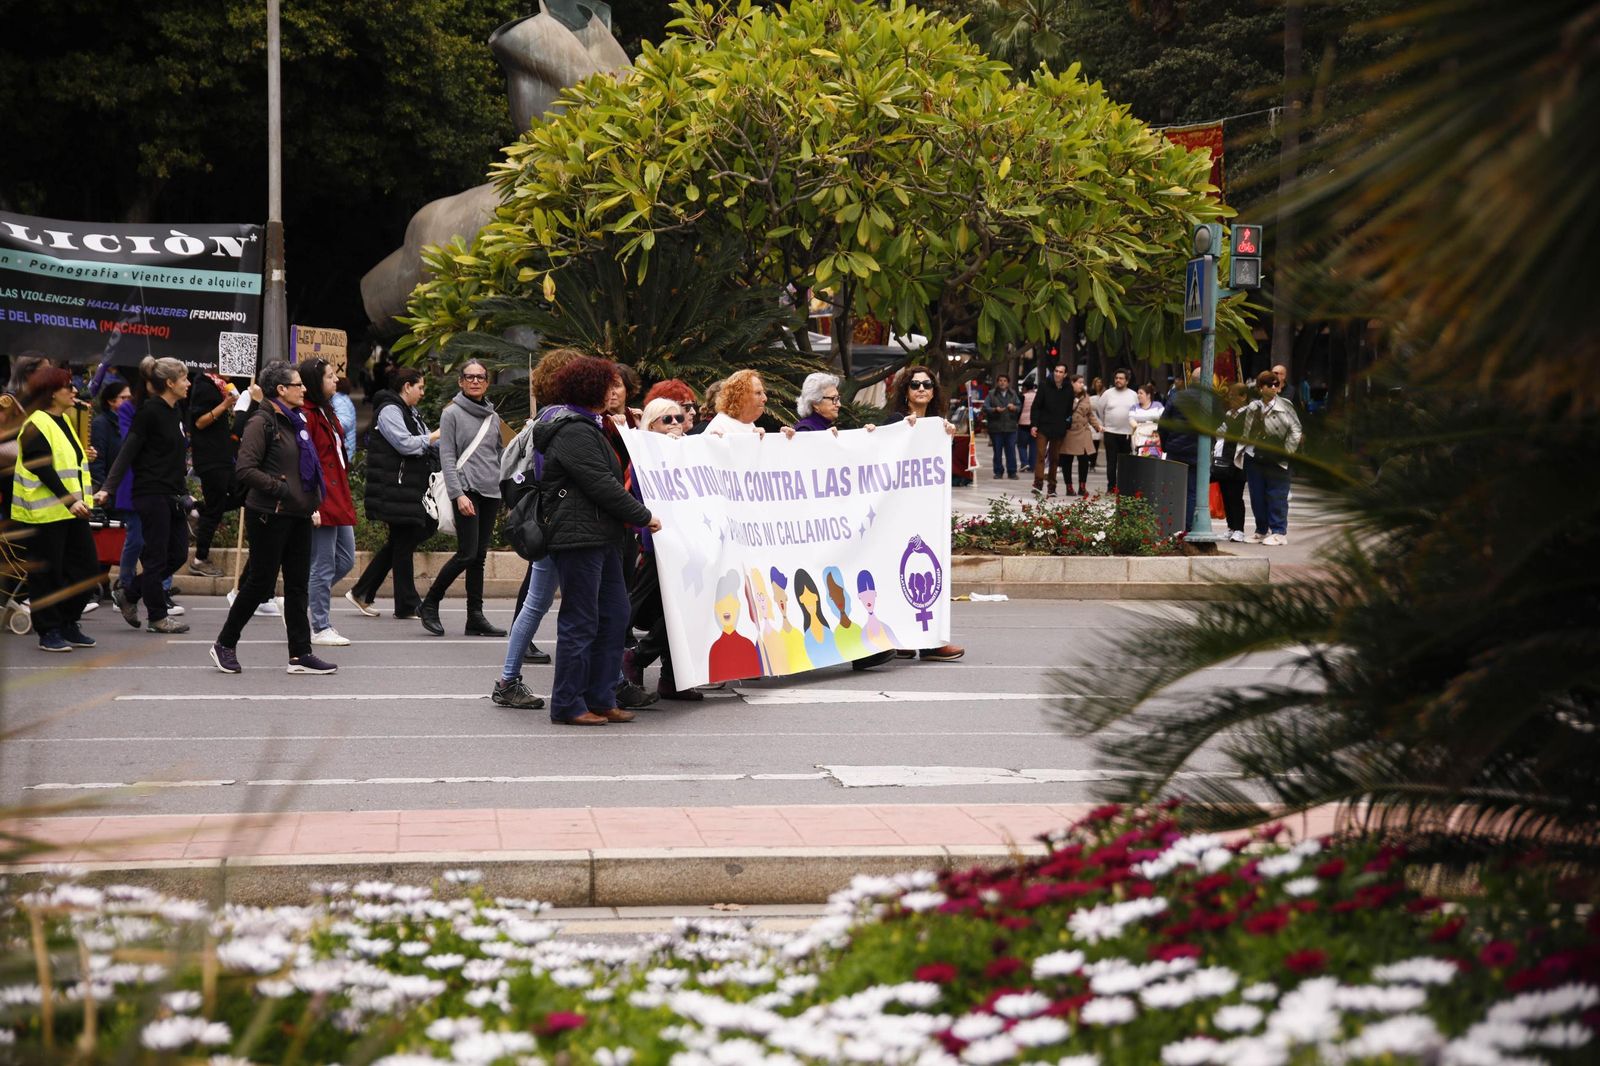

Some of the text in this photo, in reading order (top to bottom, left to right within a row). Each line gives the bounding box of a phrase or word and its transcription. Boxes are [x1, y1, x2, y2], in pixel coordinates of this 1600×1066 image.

[131, 271, 185, 284] Vientres
[189, 275, 203, 286] de
[207, 276, 254, 289] alquiler
[0, 287, 246, 323] LAS VIOLENCIAS HACIA LAS MUJERES (FEMINISMO)
[8, 309, 32, 324] DEL
[34, 311, 98, 331] PROBLEMA
[100, 319, 171, 340] (MACHISMO)
[185, 360, 198, 368] info
[649, 461, 690, 502] MÁS
[684, 465, 745, 502] VIOLCIA
[743, 470, 808, 503] CONTRA
[812, 466, 852, 499] LAS
[857, 455, 946, 495] MUJERES
[762, 520, 776, 546] NI
[776, 516, 852, 547] CALLAMOS
